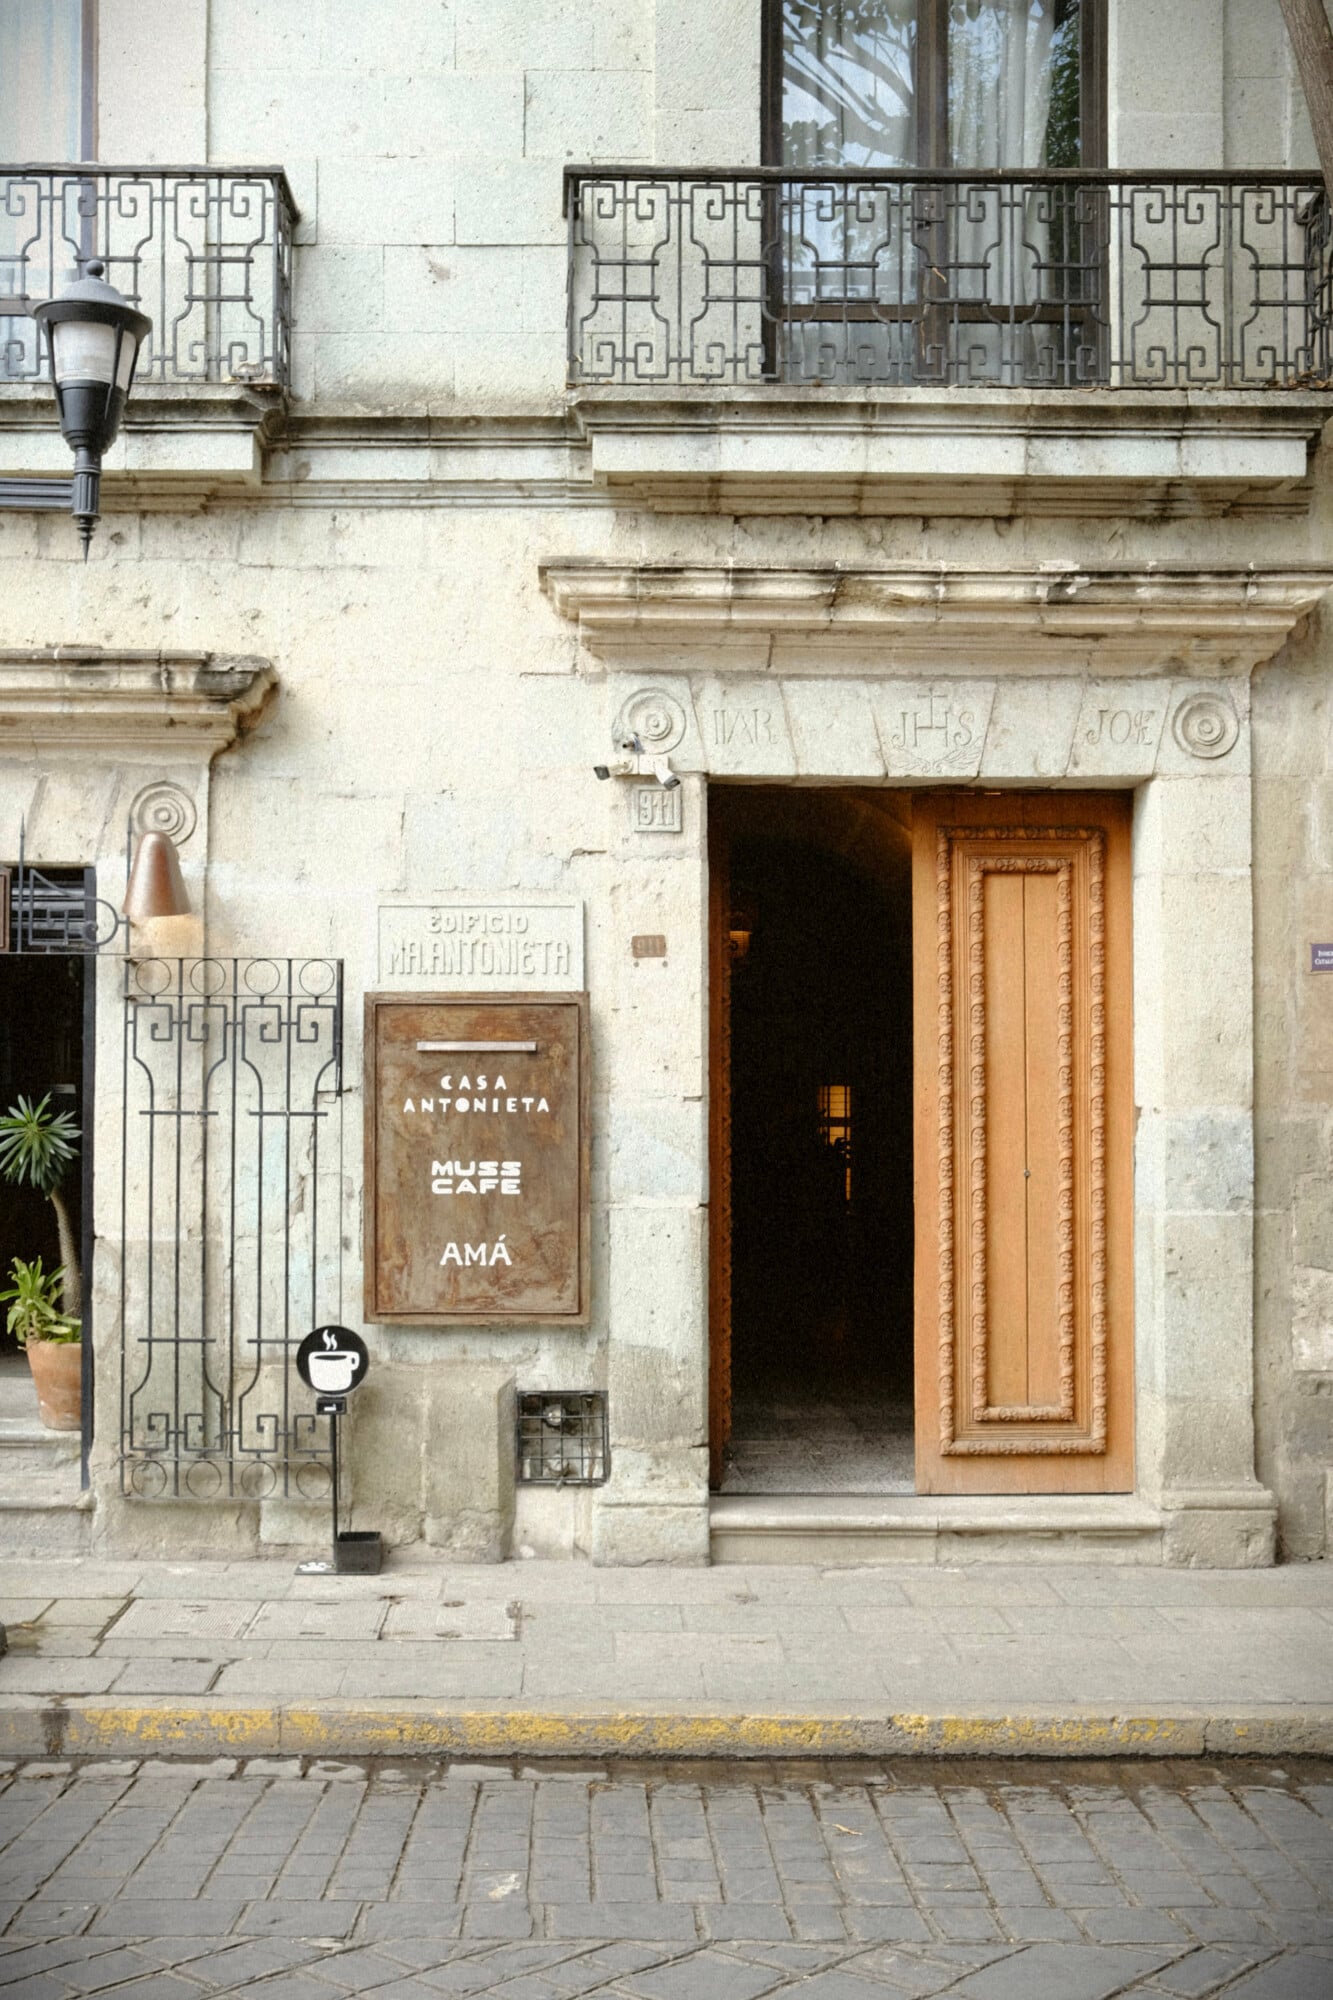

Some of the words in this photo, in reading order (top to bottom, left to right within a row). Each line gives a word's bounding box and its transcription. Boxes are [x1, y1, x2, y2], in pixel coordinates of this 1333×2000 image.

[428, 911, 529, 934] EDIFICIO
[440, 1075, 507, 1090] CASA
[403, 1097, 550, 1113] ANTONIETA
[431, 1160, 522, 1176] MUSS
[431, 1178, 521, 1195] CAFE
[440, 1234, 513, 1266] AMÁ
